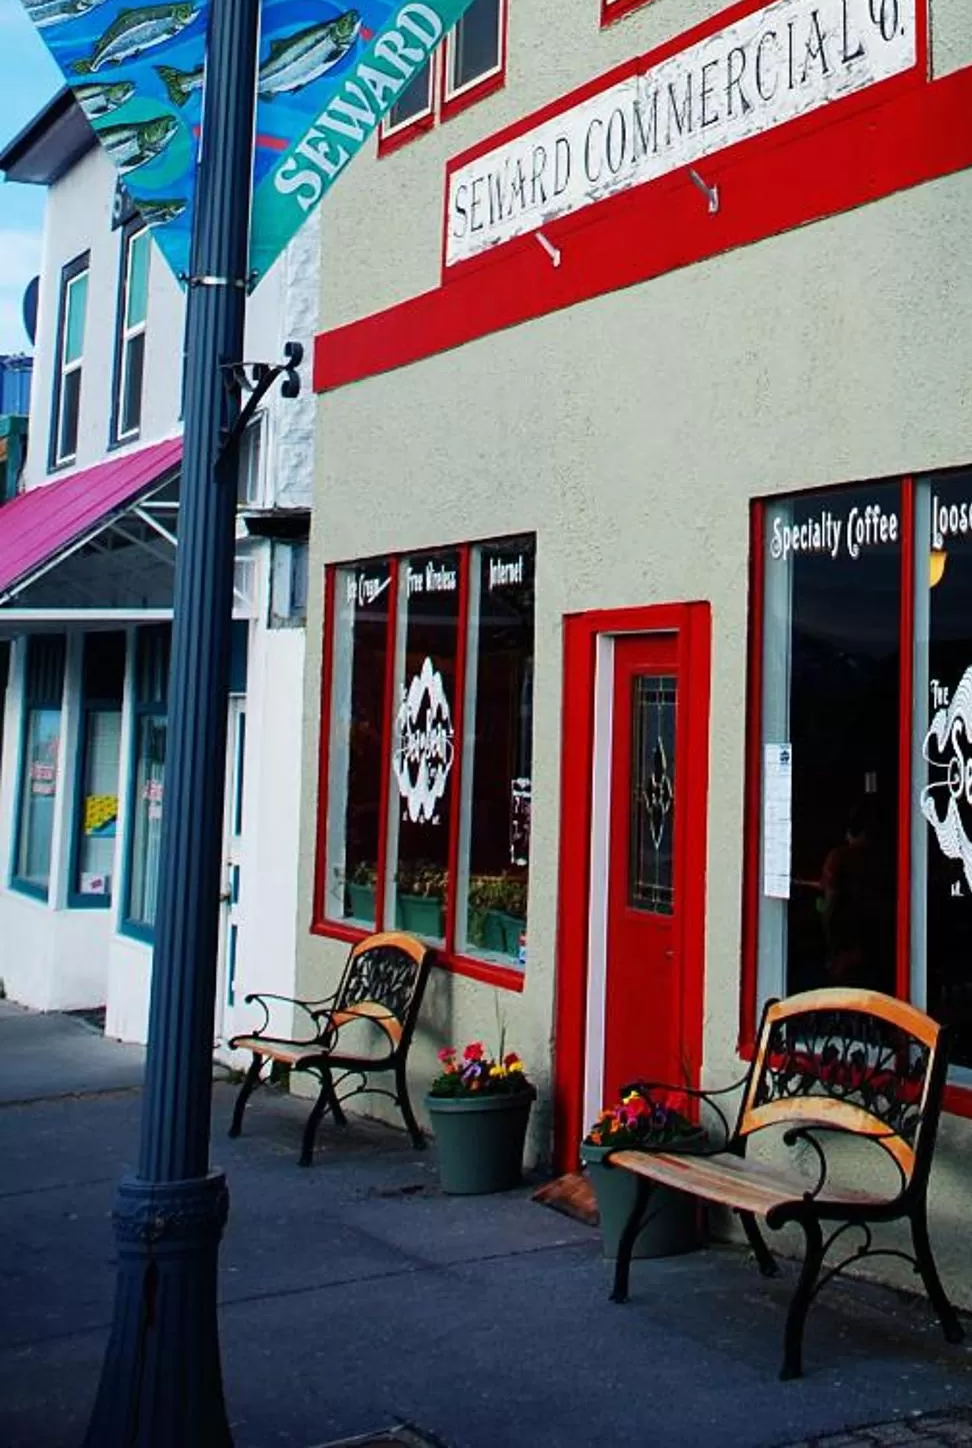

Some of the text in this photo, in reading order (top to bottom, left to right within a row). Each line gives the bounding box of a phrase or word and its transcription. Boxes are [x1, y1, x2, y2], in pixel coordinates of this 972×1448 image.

[273, 2, 444, 212] SEWARD
[453, 136, 571, 239] SEWARD
[771, 503, 899, 559] Specialty Coffee
[406, 561, 457, 599] Free Wireless
[488, 555, 523, 591] Internet
